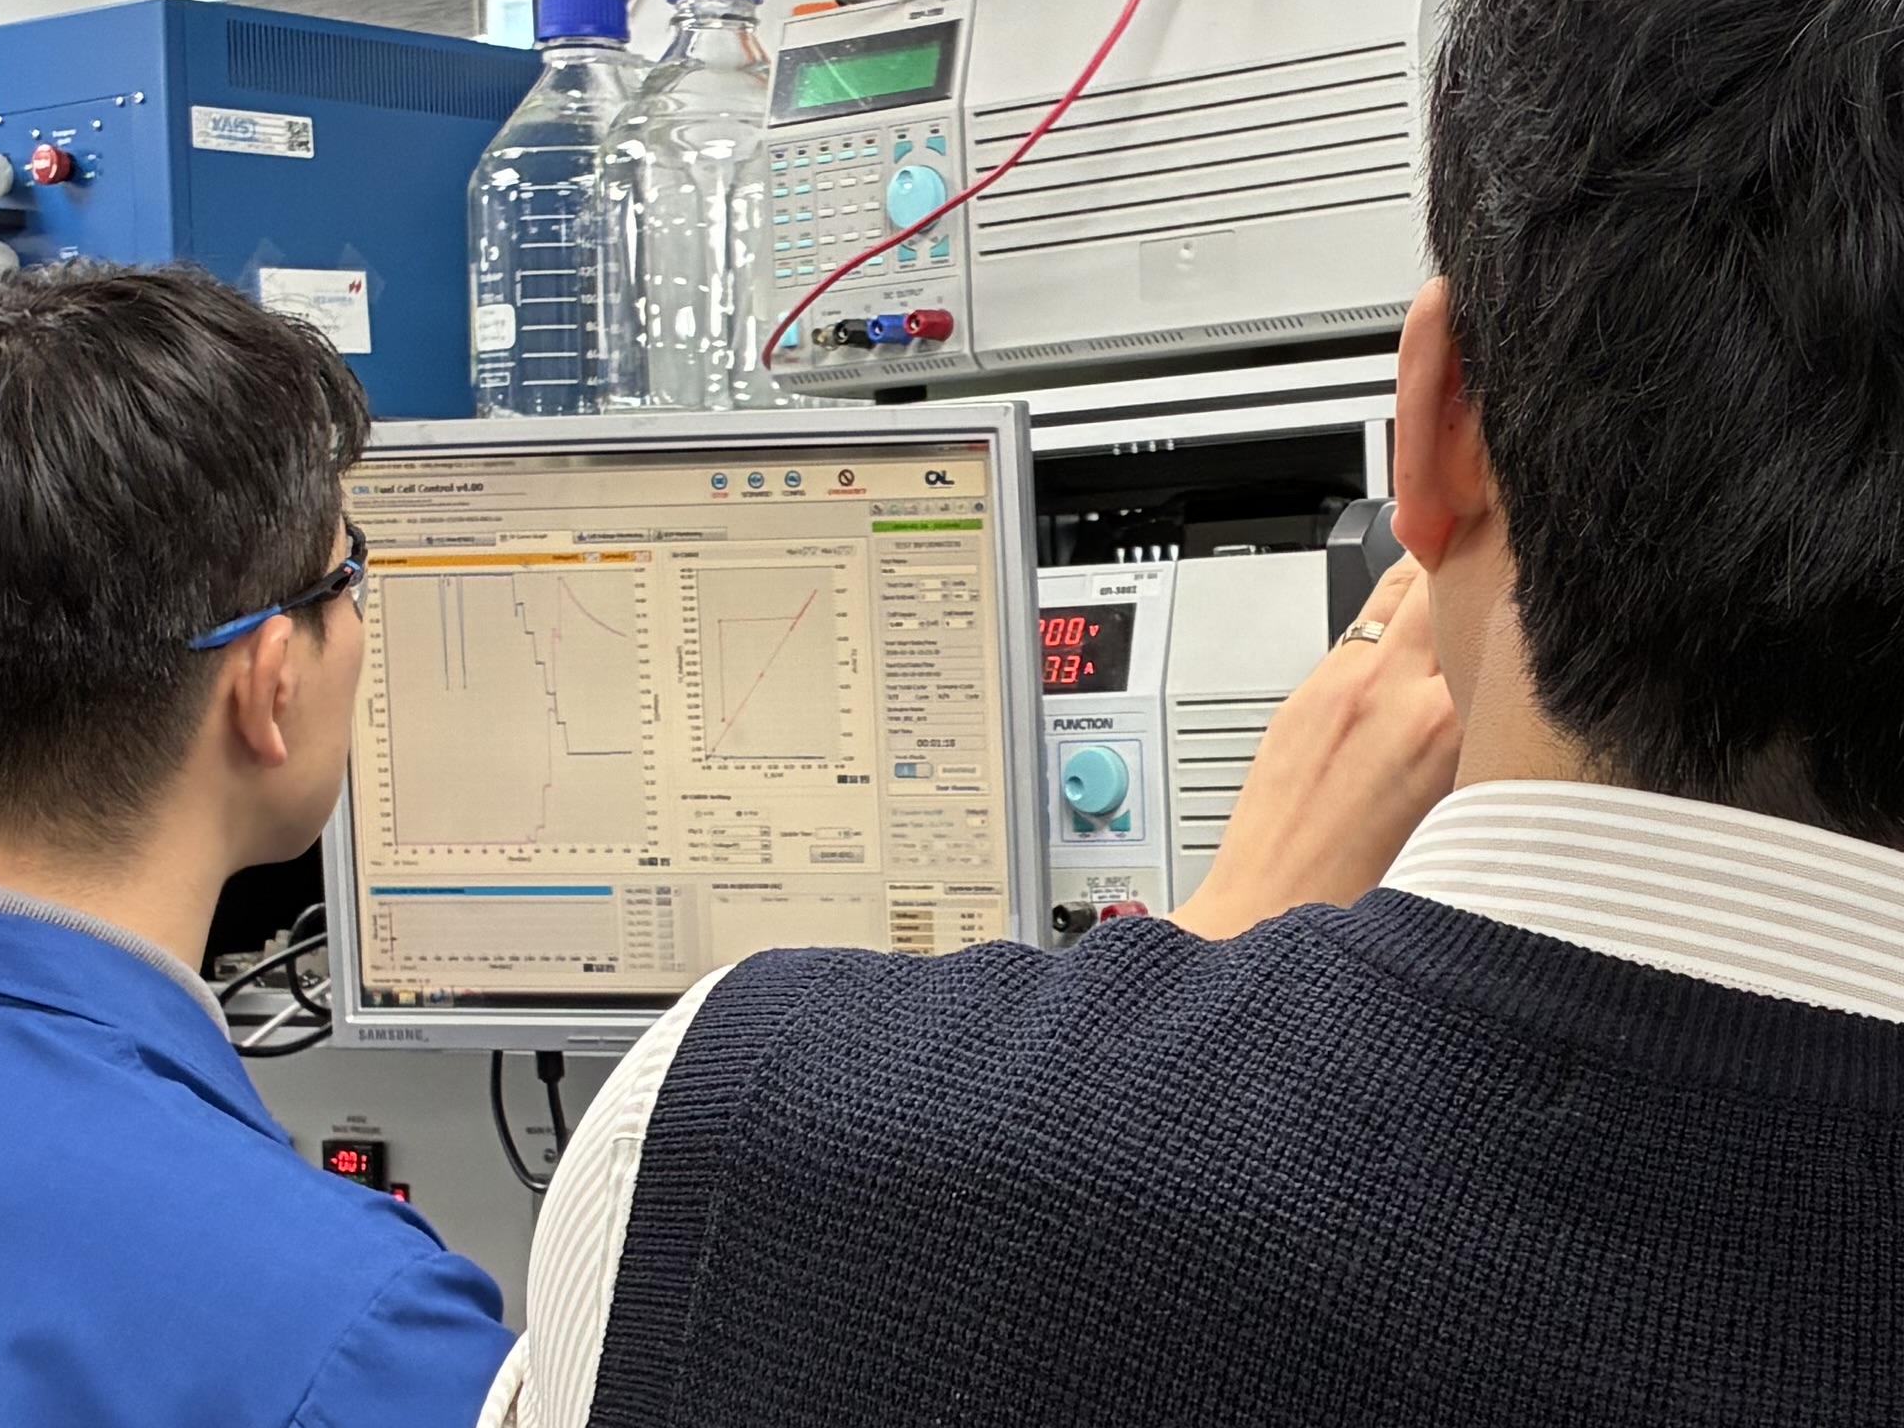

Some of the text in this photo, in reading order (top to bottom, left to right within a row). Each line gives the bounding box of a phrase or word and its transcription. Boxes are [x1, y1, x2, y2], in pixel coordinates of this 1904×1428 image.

[418, 482, 455, 493] Control
[1088, 625, 1100, 638] V
[1083, 662, 1095, 675] A
[1053, 718, 1113, 731] FUNCTION
[358, 1028, 424, 1042] SAMSUNG
